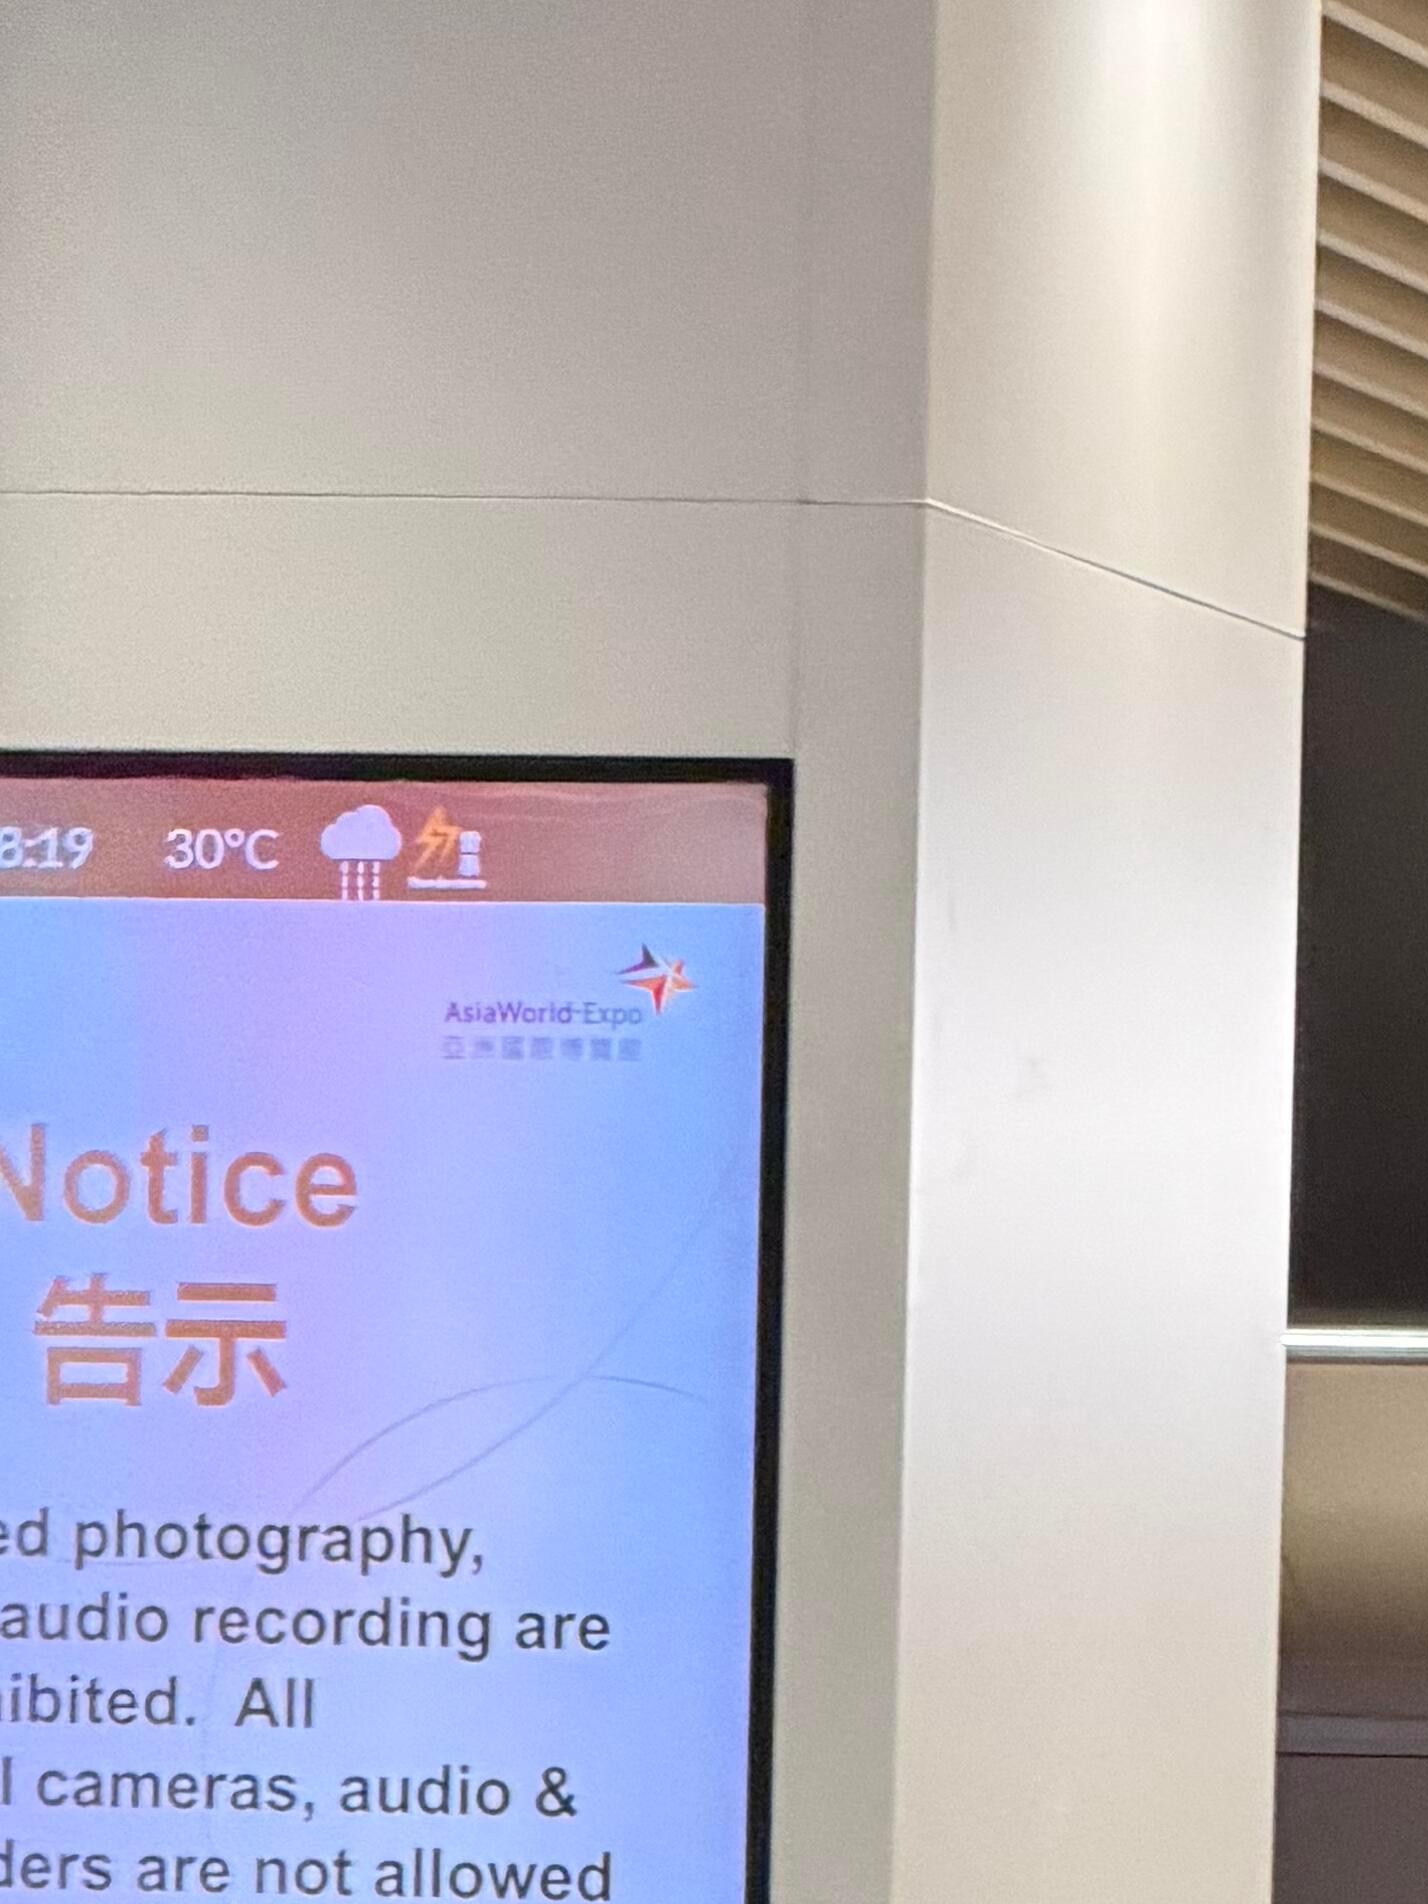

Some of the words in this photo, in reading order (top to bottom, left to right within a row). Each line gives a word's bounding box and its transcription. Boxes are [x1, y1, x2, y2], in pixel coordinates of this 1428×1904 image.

[164, 828, 281, 870] 30°C
[0, 1122, 357, 1228] Notice
[33, 1272, 287, 1407] 告示
[75, 1509, 482, 1578] photography,
[0, 1591, 168, 1642] audio
[195, 1597, 490, 1662] recording
[516, 1612, 610, 1650] are
[0, 1673, 195, 1726] ibited.
[235, 1677, 313, 1728] All
[37, 1770, 314, 1821] cameras,
[340, 1764, 510, 1816] audio
[536, 1767, 577, 1817] &
[138, 1855, 229, 1893] are
[256, 1848, 352, 1897] not
[375, 1848, 611, 1902] allowed
